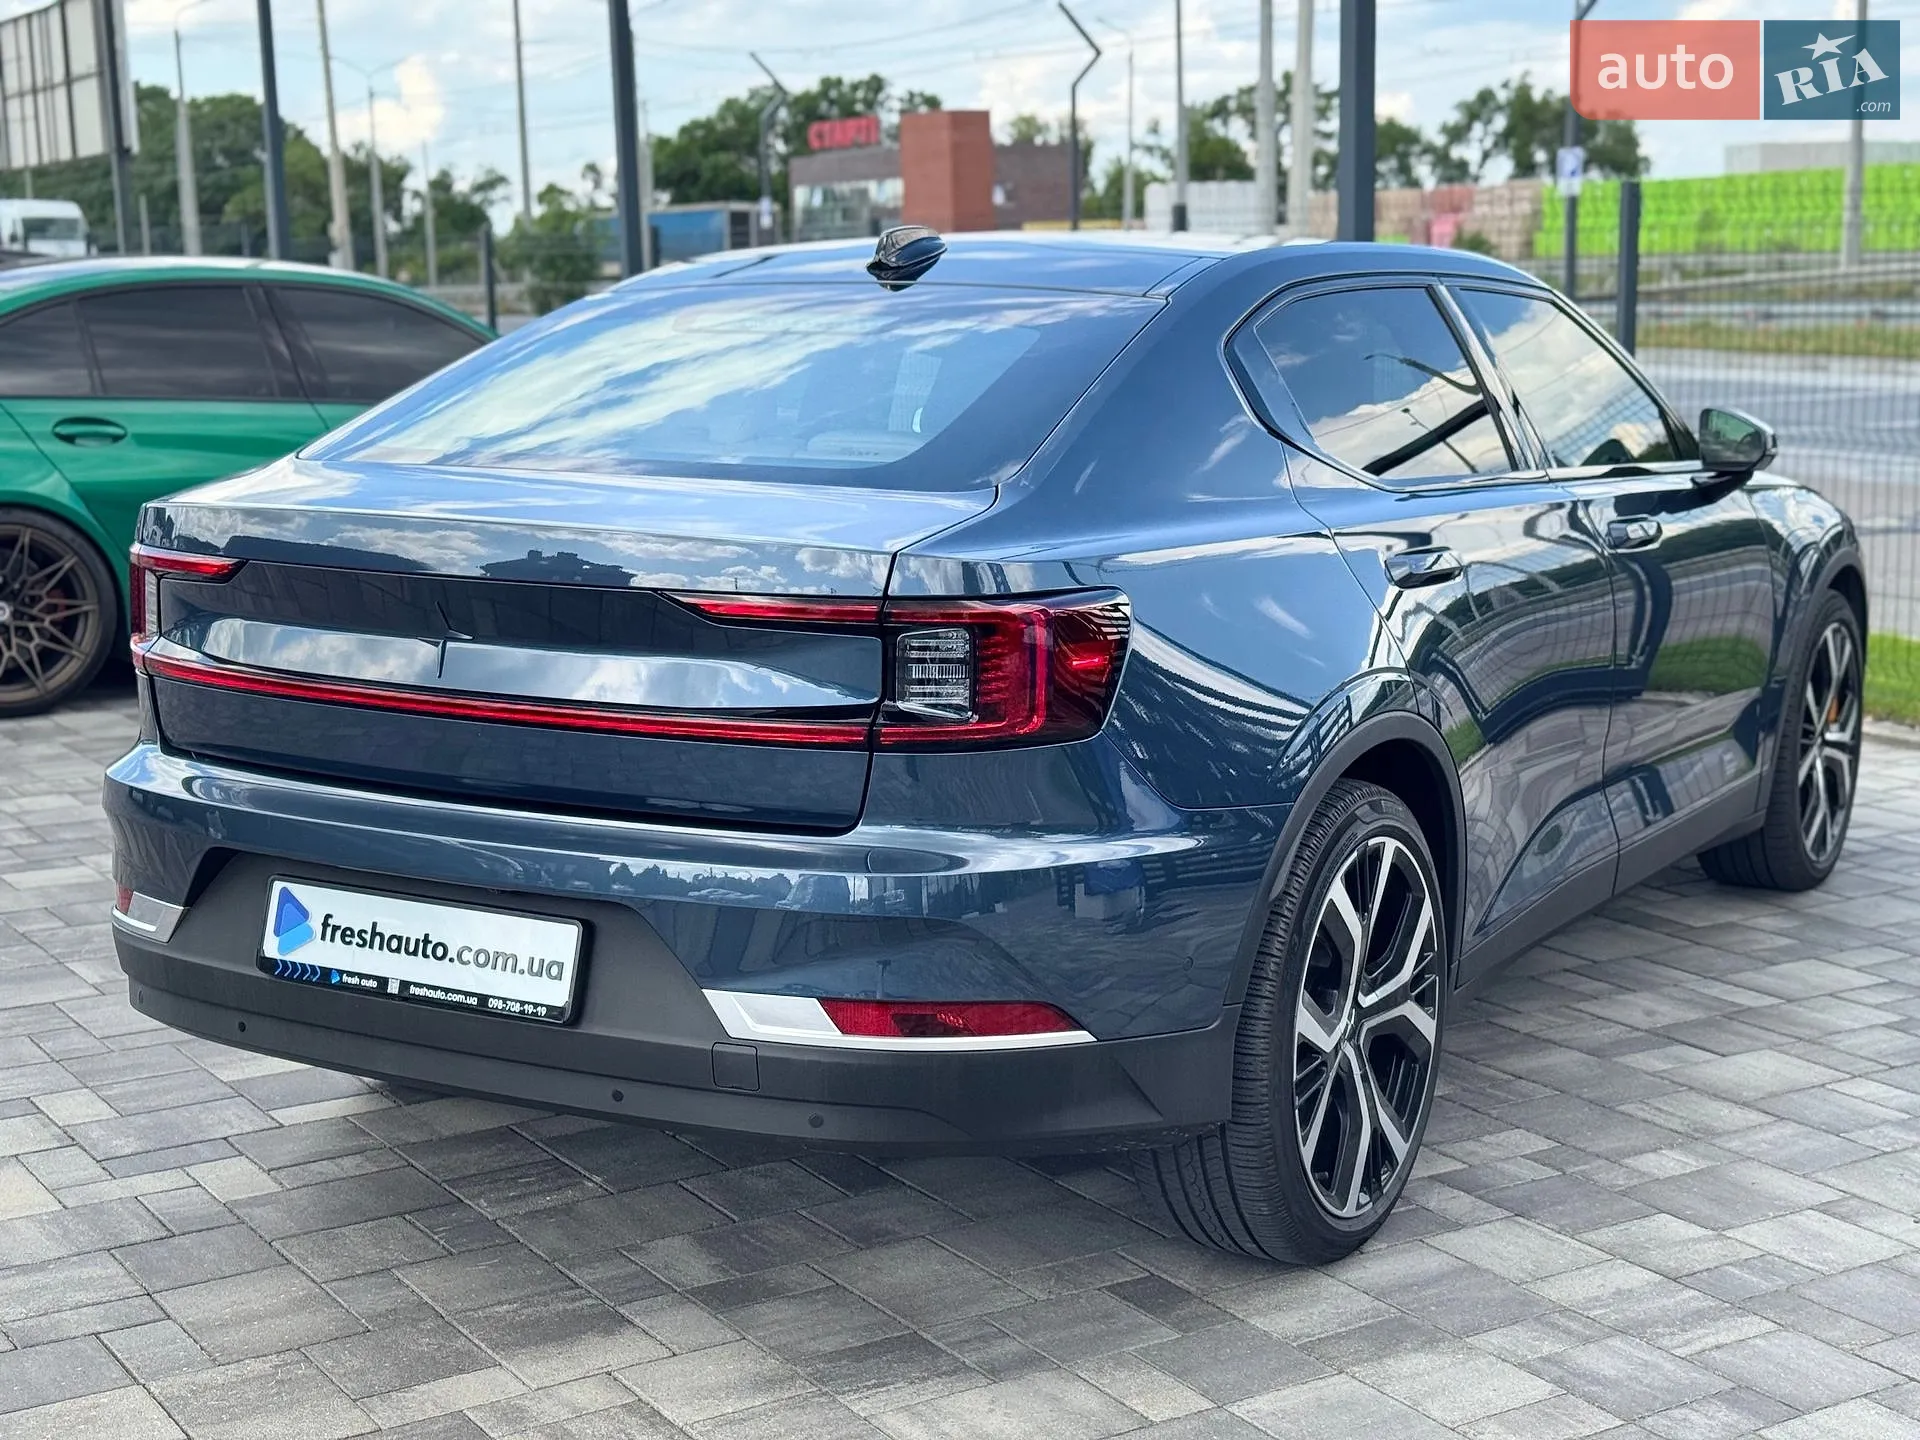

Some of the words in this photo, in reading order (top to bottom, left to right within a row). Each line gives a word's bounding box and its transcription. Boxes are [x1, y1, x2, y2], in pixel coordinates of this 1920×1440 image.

[320, 913, 565, 982] freshauto.com.ua
[342, 973, 360, 986] fresh
[361, 977, 378, 989] auto
[409, 984, 479, 1006] freshauto.com.ua
[487, 998, 548, 1017] 098-708-19-19
